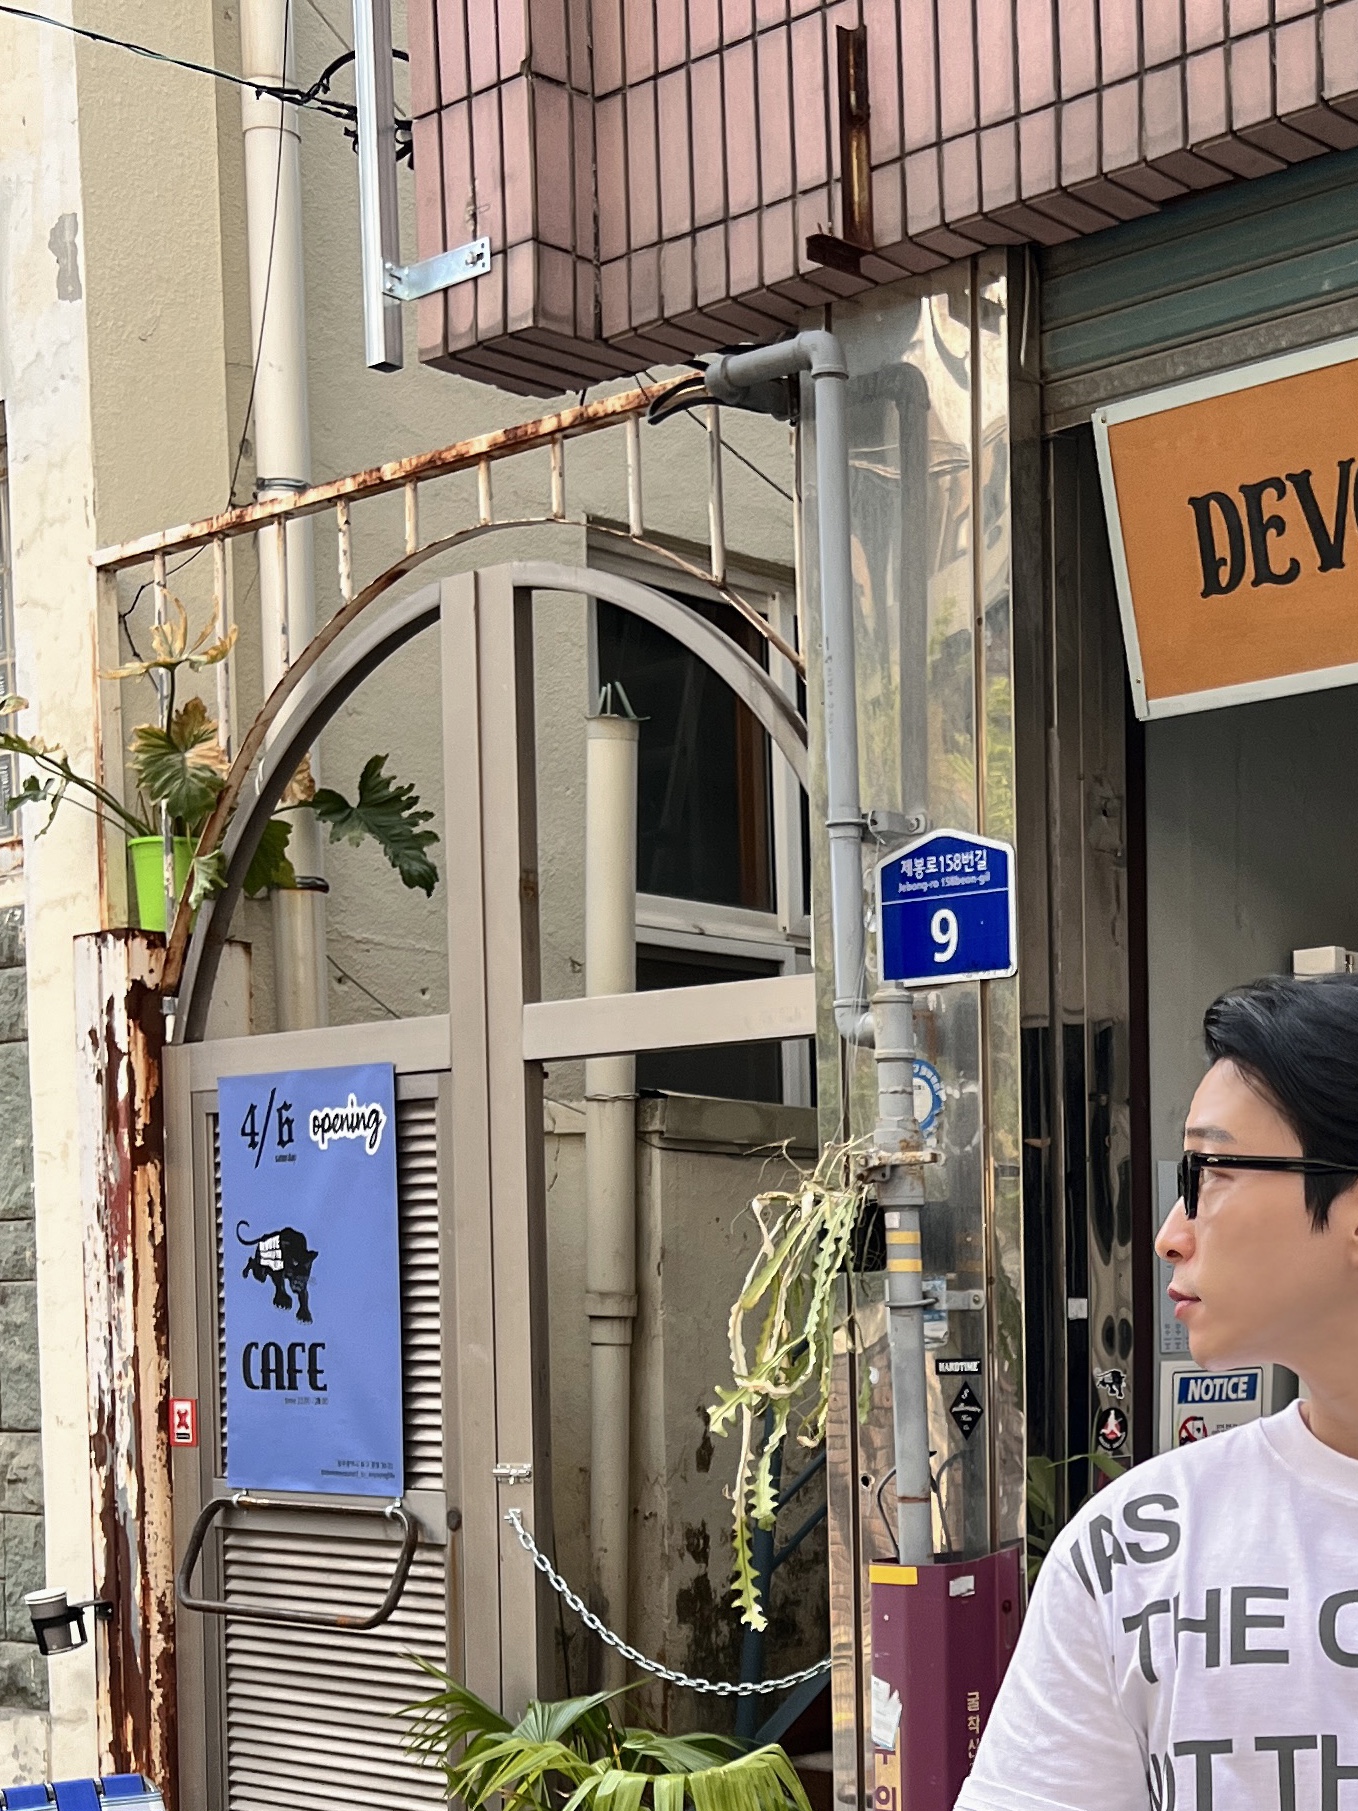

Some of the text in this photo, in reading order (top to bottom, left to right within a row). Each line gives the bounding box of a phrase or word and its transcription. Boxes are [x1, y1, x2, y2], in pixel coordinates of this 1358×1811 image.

[900, 849, 988, 880] 제봉로158번길
[930, 907, 959, 963] 9
[240, 1087, 382, 1169] 4/6 opening
[242, 1341, 328, 1392] CAFE
[1187, 1376, 1249, 1402] NOTICE
[1122, 1586, 1290, 1685] THE
